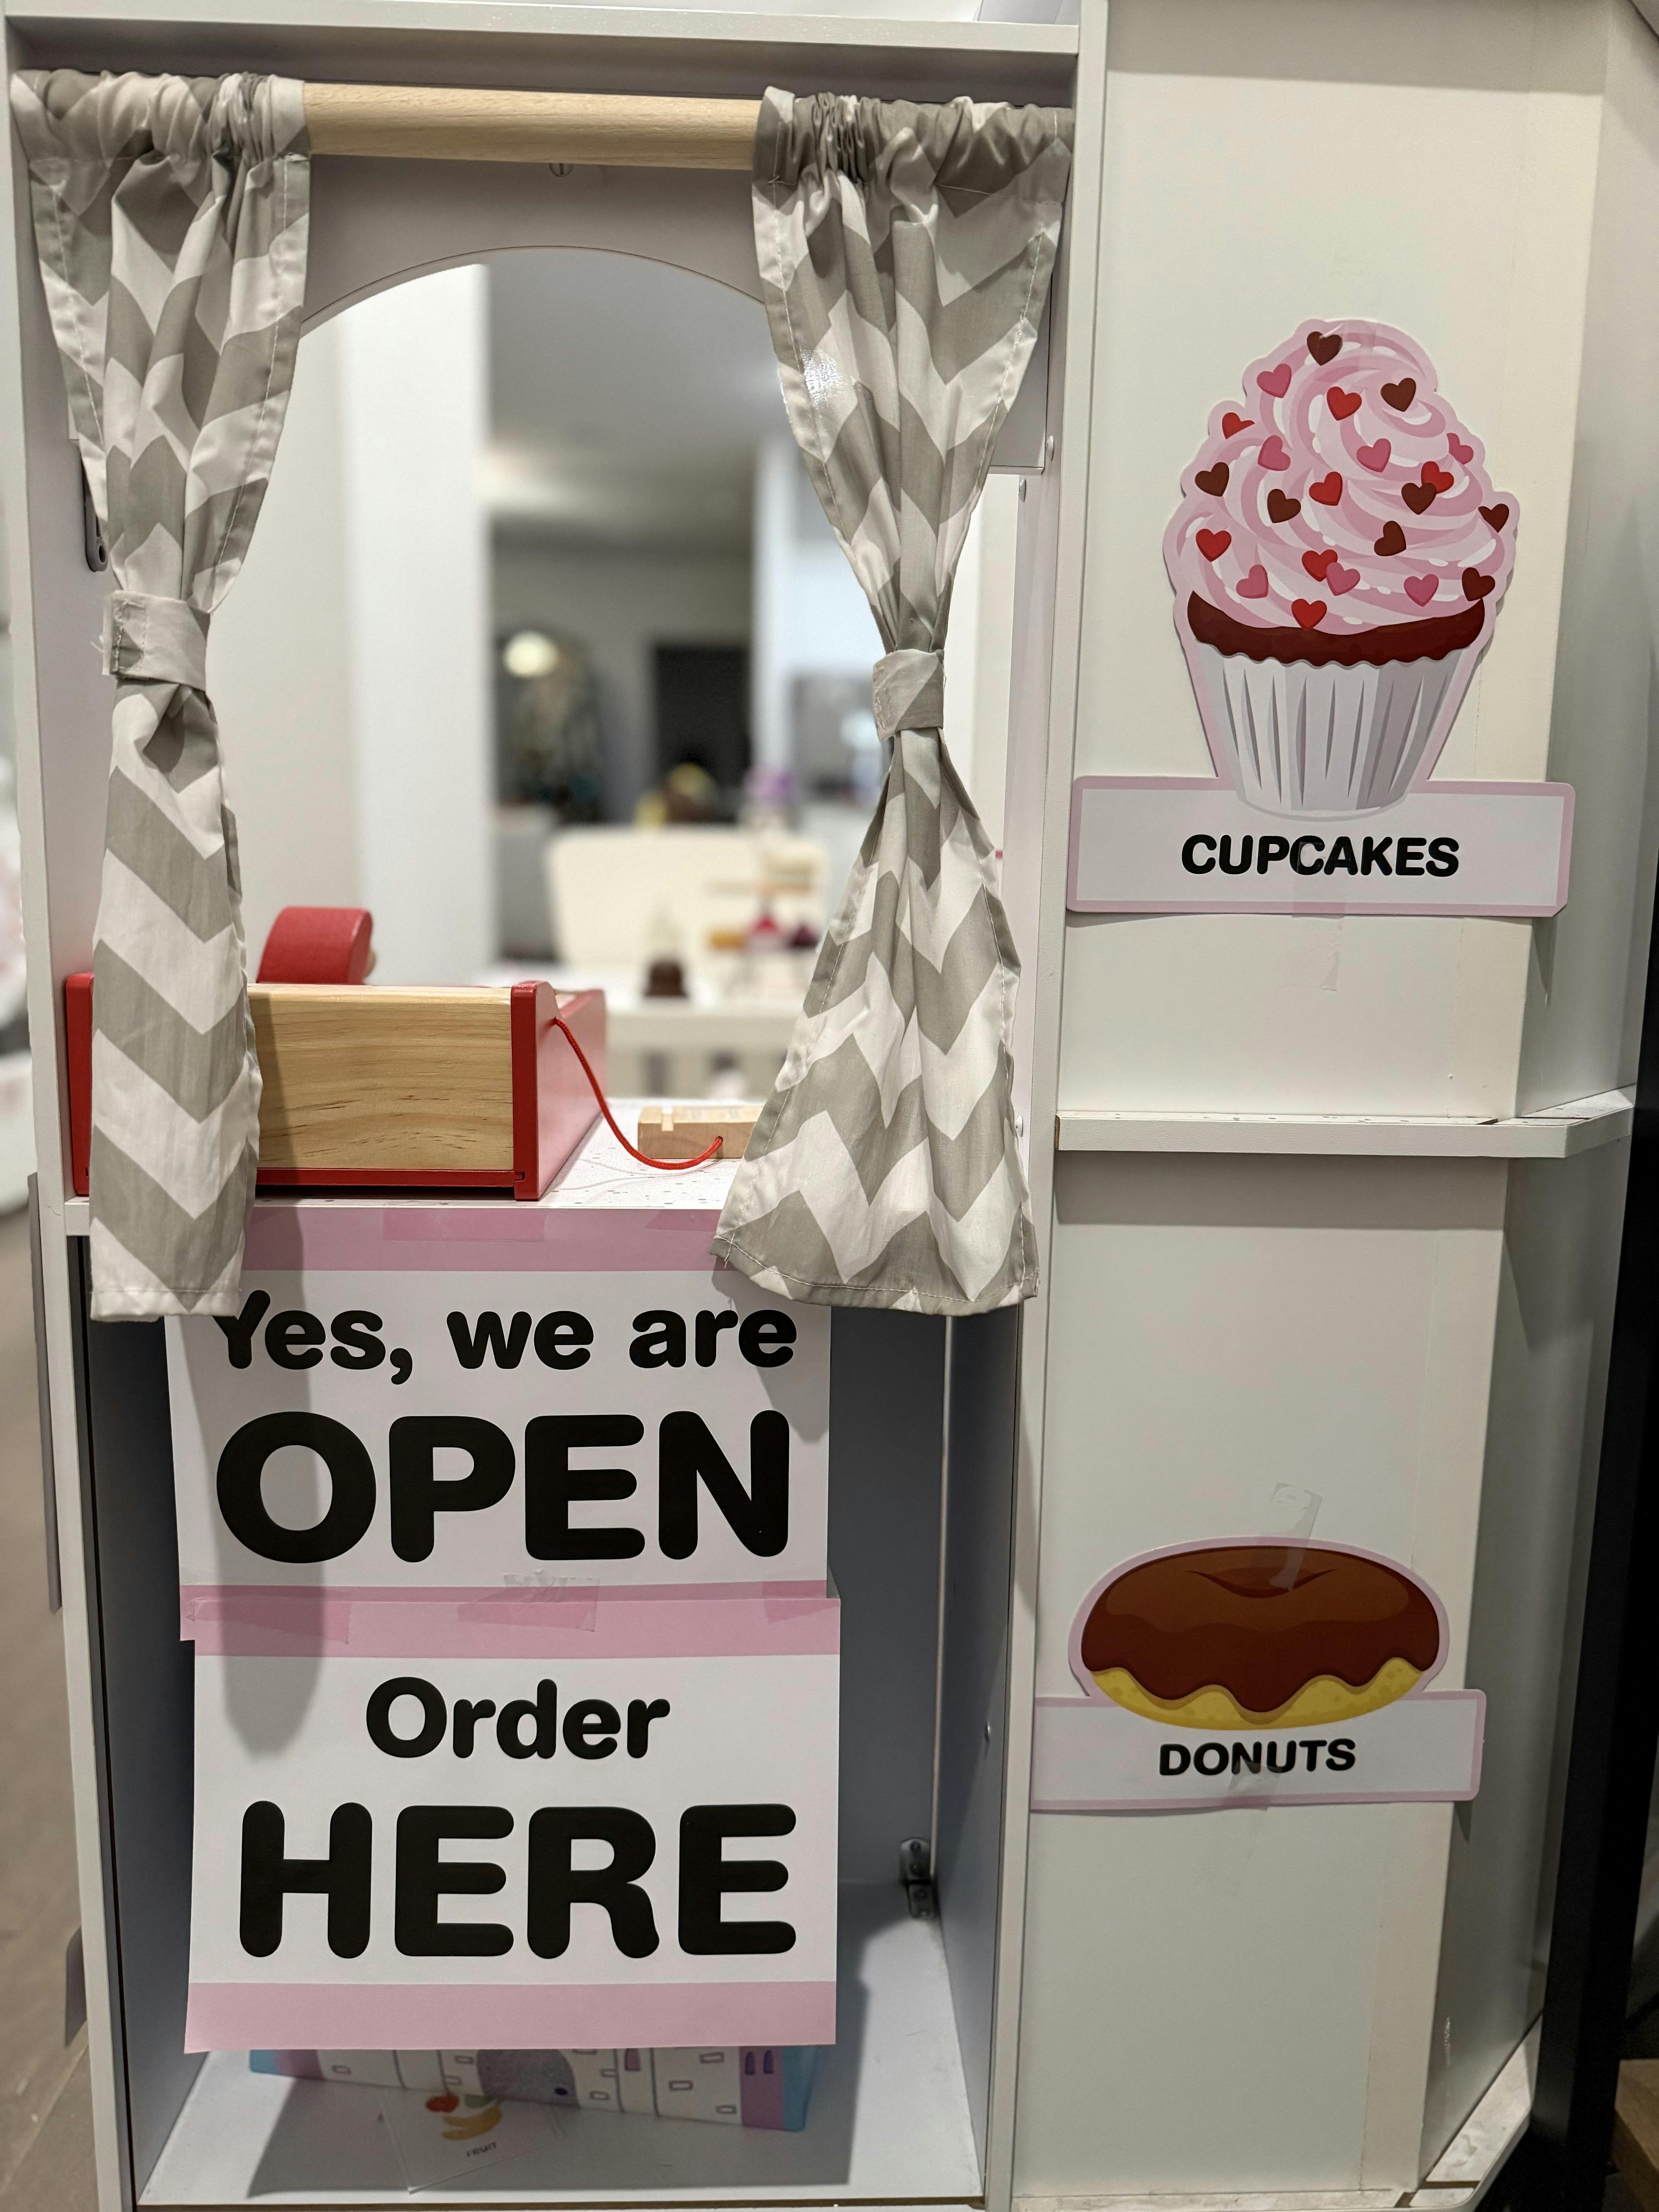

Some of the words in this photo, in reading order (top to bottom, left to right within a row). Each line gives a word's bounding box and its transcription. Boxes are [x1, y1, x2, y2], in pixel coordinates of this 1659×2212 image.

[1181, 834, 1460, 878] CUPCAKES
[212, 1289, 413, 1385] Yes,
[446, 1310, 594, 1370] we
[629, 1309, 797, 1369] are
[216, 1410, 790, 1564] OPEN
[366, 1676, 671, 1760] Order
[1159, 1738, 1356, 1776] DONUTS
[239, 1800, 797, 1960] HERE
[466, 2142, 497, 2157] FRUIT
